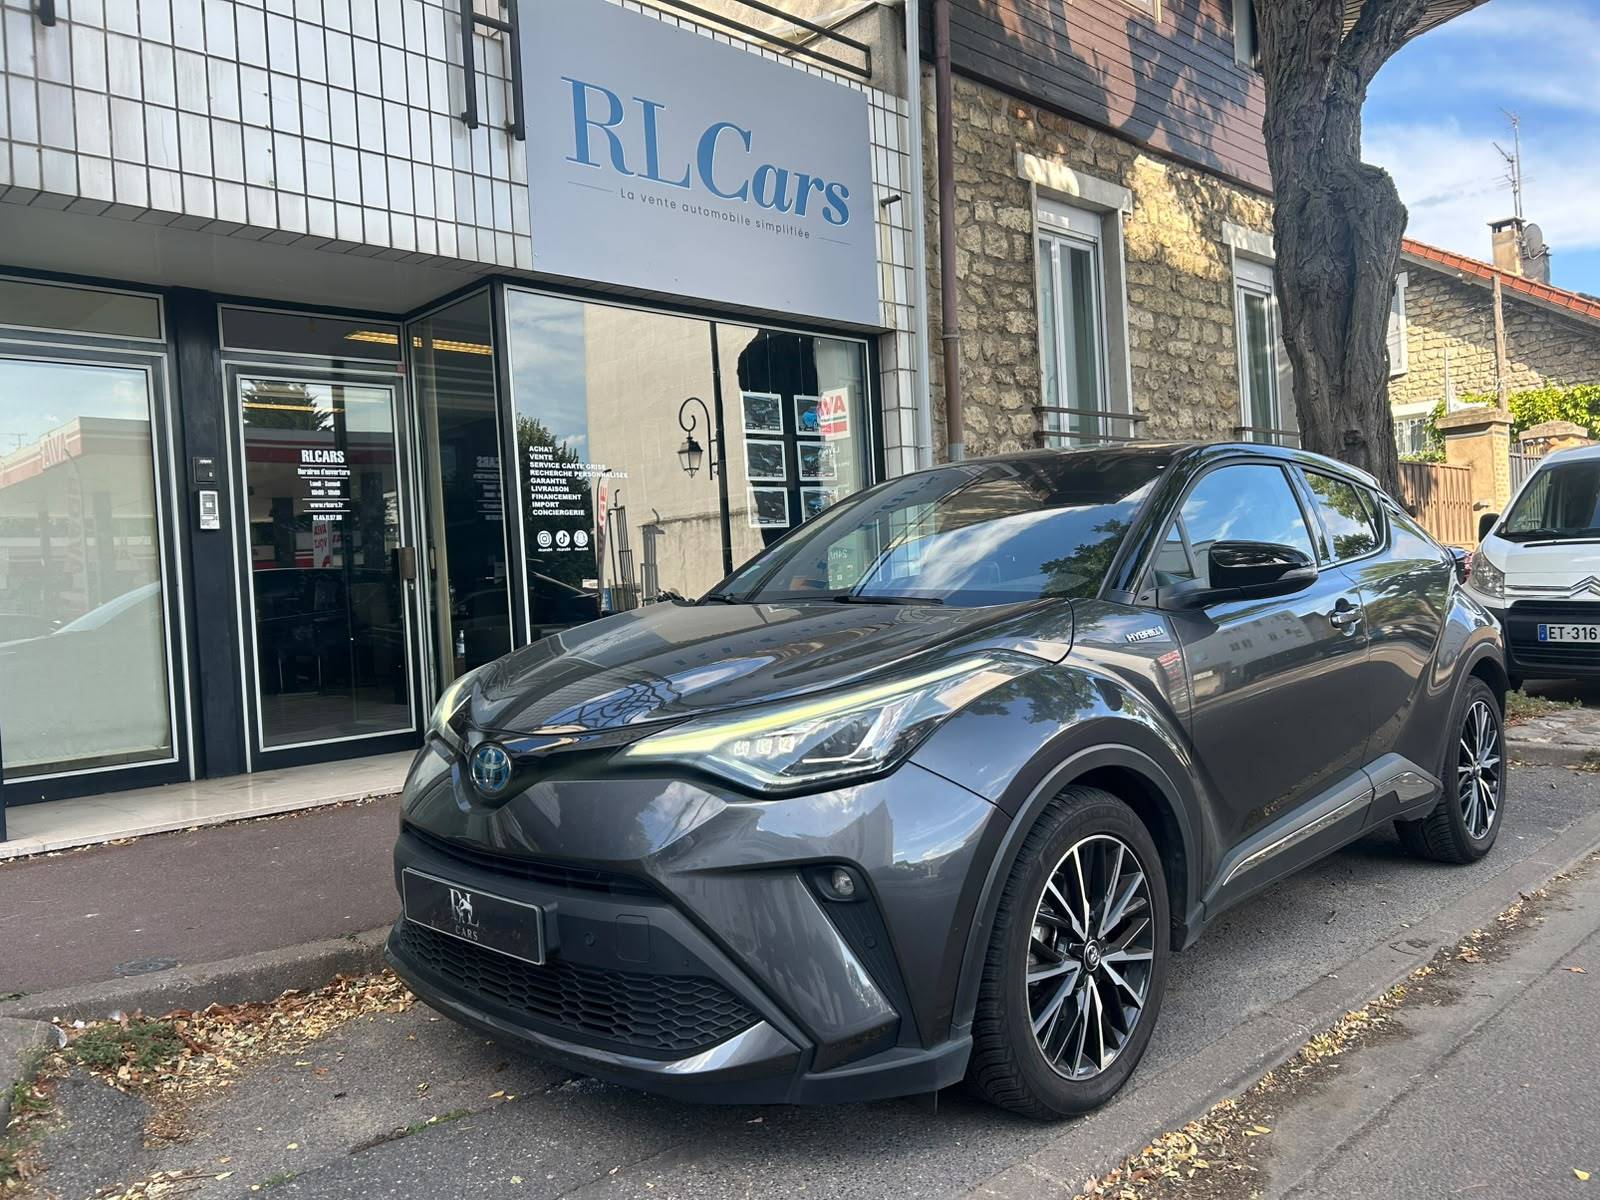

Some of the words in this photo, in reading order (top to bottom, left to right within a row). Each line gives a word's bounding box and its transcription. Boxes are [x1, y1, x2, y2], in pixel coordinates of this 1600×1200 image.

[620, 188, 635, 201] La
[641, 192, 677, 210] vente
[682, 203, 751, 227] automobile
[755, 216, 811, 240] simplifiée
[301, 450, 345, 463] RLCARS
[455, 924, 478, 941] CARS
